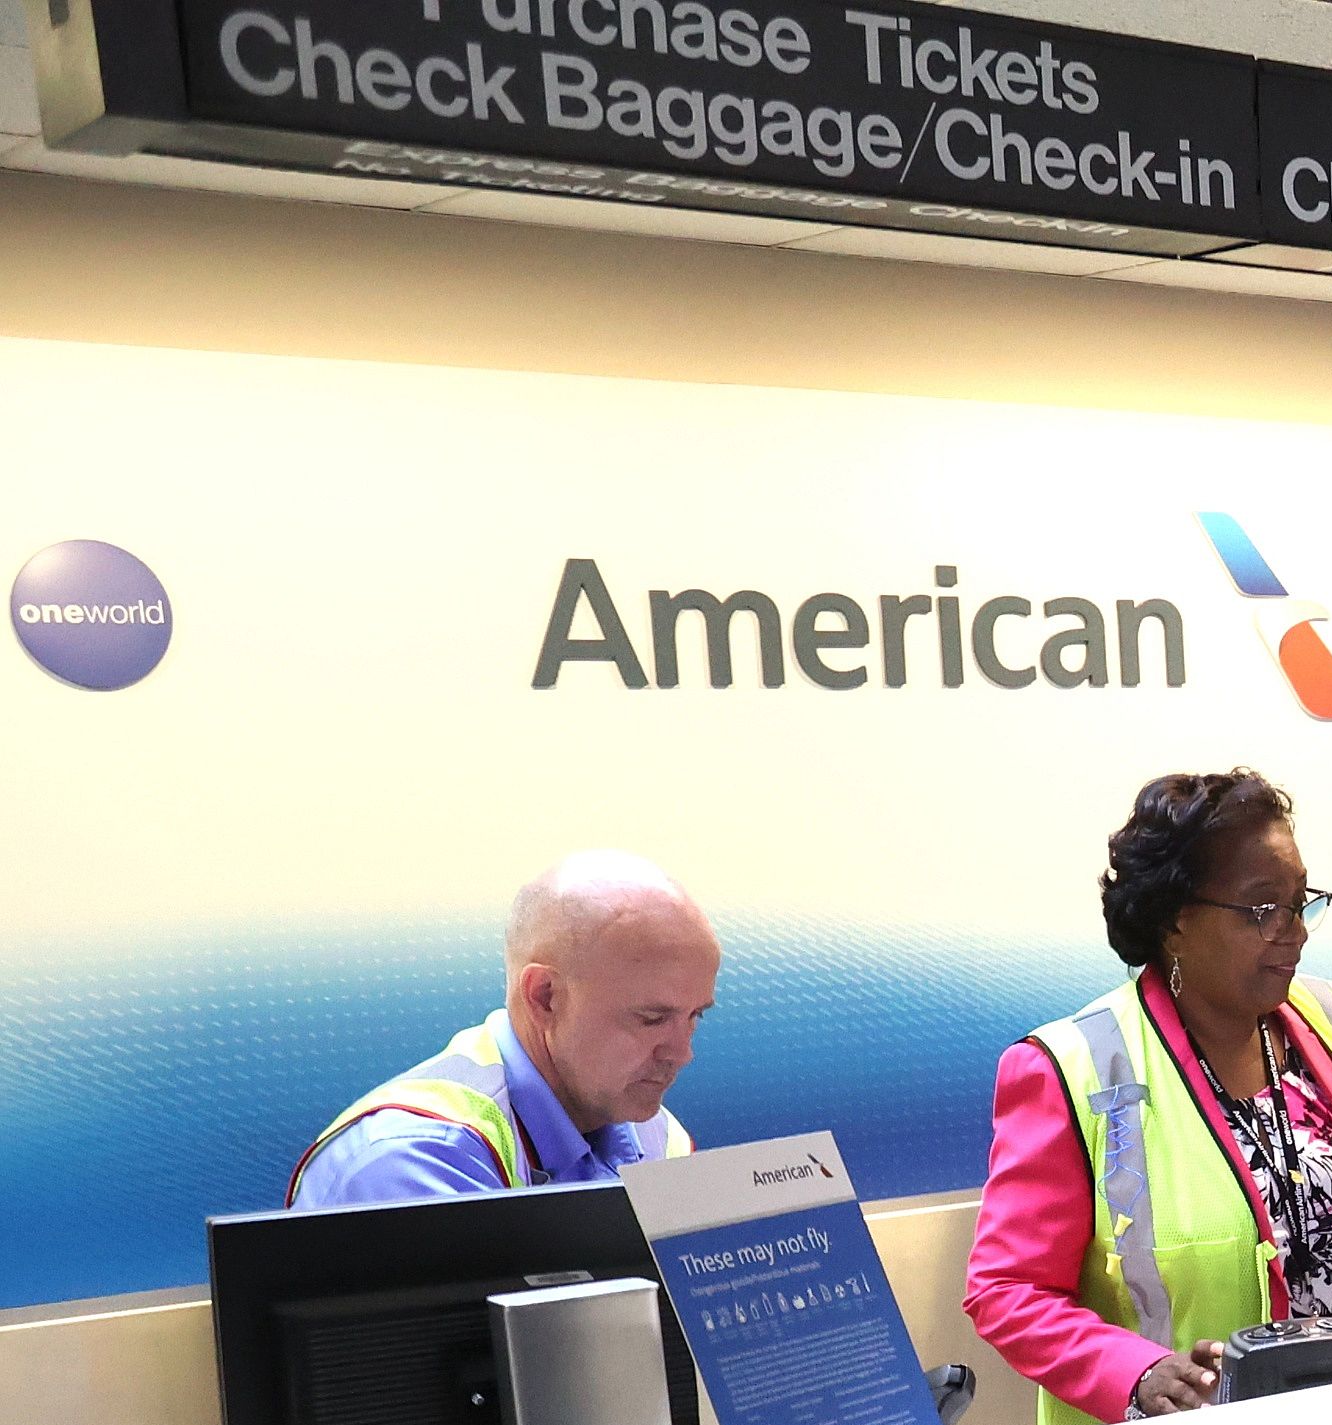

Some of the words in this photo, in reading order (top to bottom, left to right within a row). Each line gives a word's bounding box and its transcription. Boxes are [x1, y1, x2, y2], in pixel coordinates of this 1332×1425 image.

[422, 0, 813, 75] urchase
[845, 9, 1100, 115] Tickets
[219, 11, 526, 126] Check
[540, 51, 1236, 210] Baggage/Check-in
[19, 599, 166, 626] oneworld
[529, 557, 1186, 691] American
[1199, 1059, 1224, 1094] oneworld
[1279, 1110, 1293, 1146] oneworld
[753, 1164, 815, 1187] American
[678, 1252, 735, 1277] These
[737, 1241, 775, 1266] may
[777, 1233, 808, 1257] not
[806, 1227, 833, 1254] fly.
